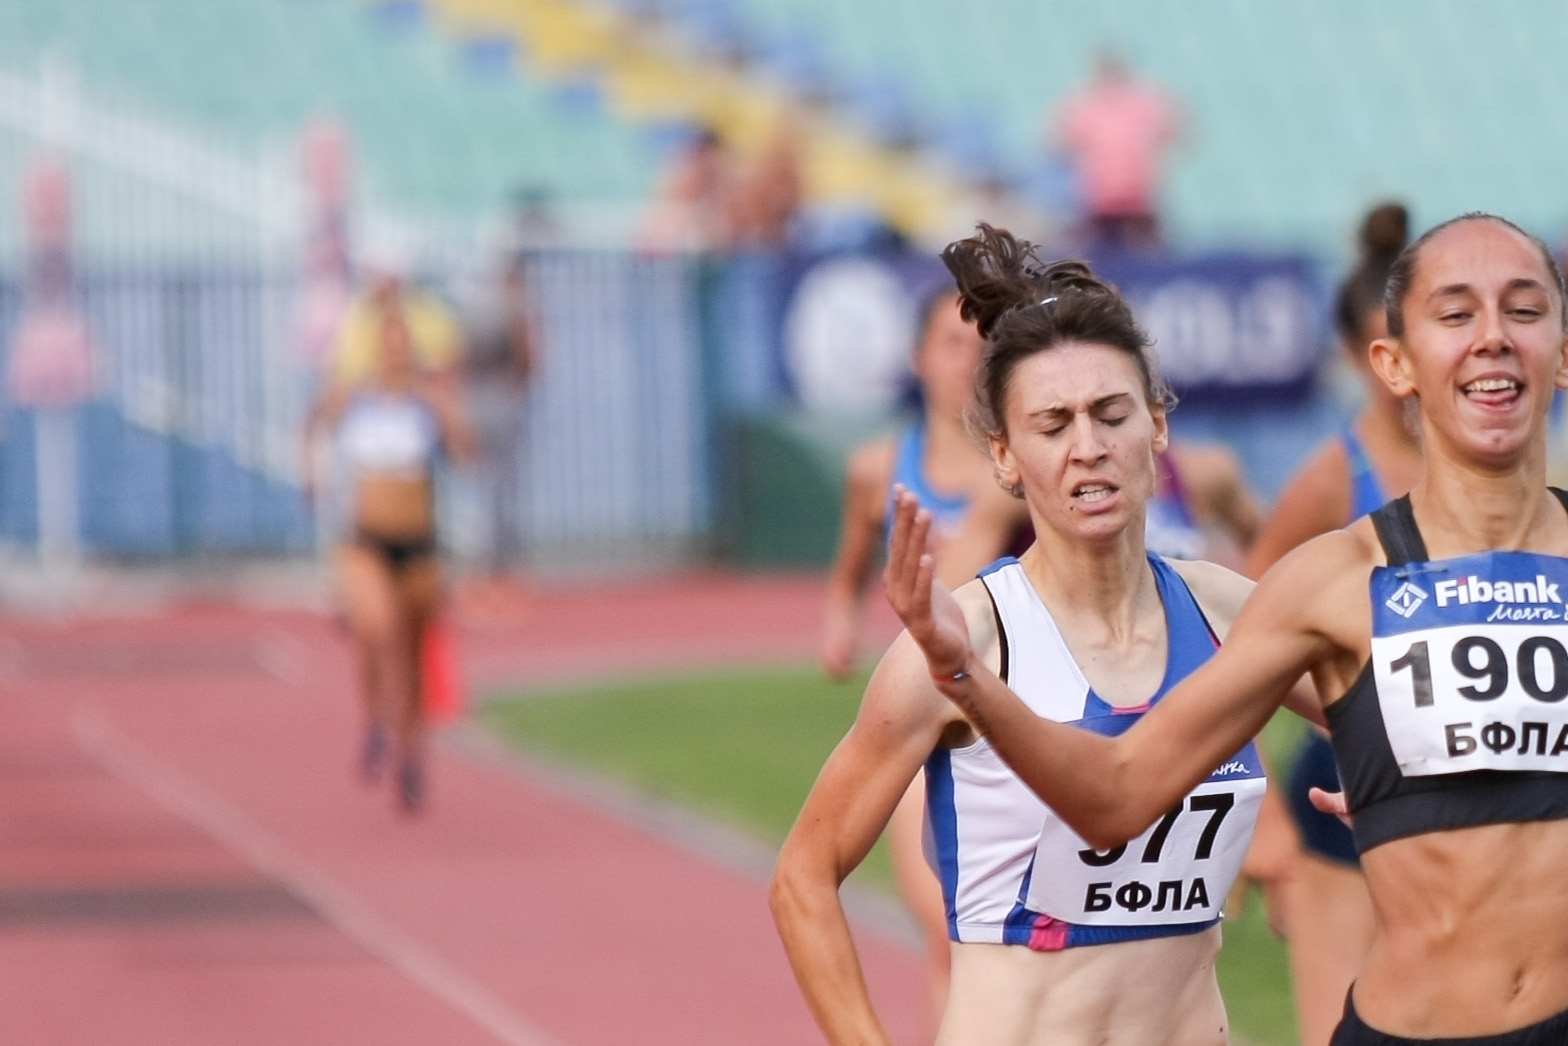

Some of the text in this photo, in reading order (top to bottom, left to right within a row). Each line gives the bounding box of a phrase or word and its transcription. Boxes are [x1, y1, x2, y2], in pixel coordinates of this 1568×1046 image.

[1434, 575, 1562, 608] Fibank
[1487, 603, 1561, 622] Моята
[1083, 877, 1210, 913] БФЛА
